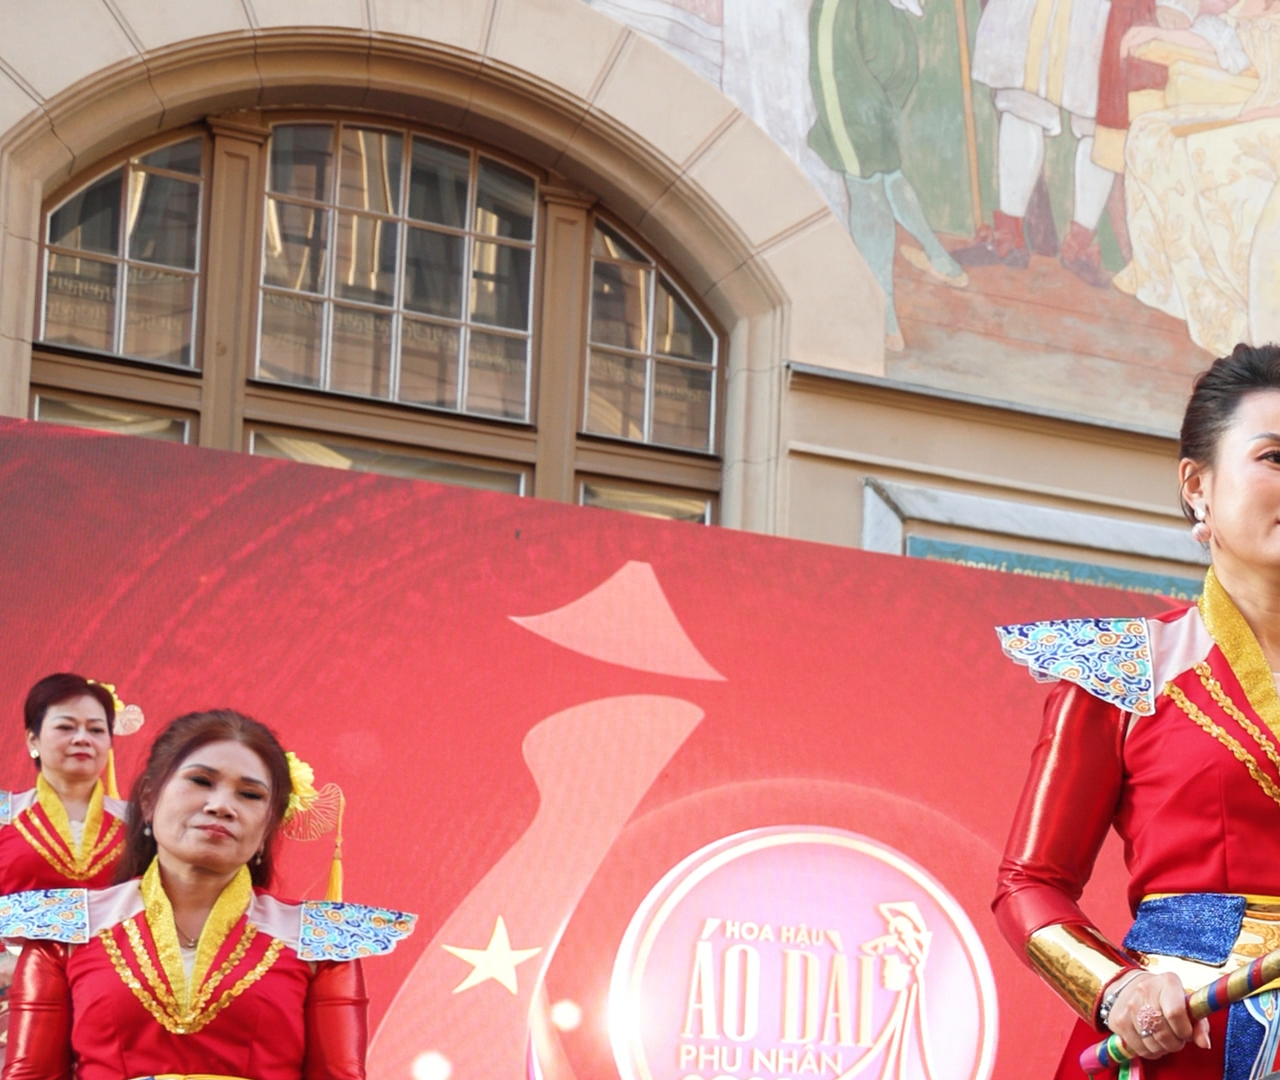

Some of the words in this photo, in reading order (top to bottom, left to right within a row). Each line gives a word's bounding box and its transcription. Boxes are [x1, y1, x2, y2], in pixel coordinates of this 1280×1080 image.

[725, 919, 775, 943] HOA
[780, 924, 825, 949] HẬU
[680, 917, 761, 1042] ÁO
[780, 929, 876, 1049] DÀI
[752, 1043, 844, 1076] NHÂN
